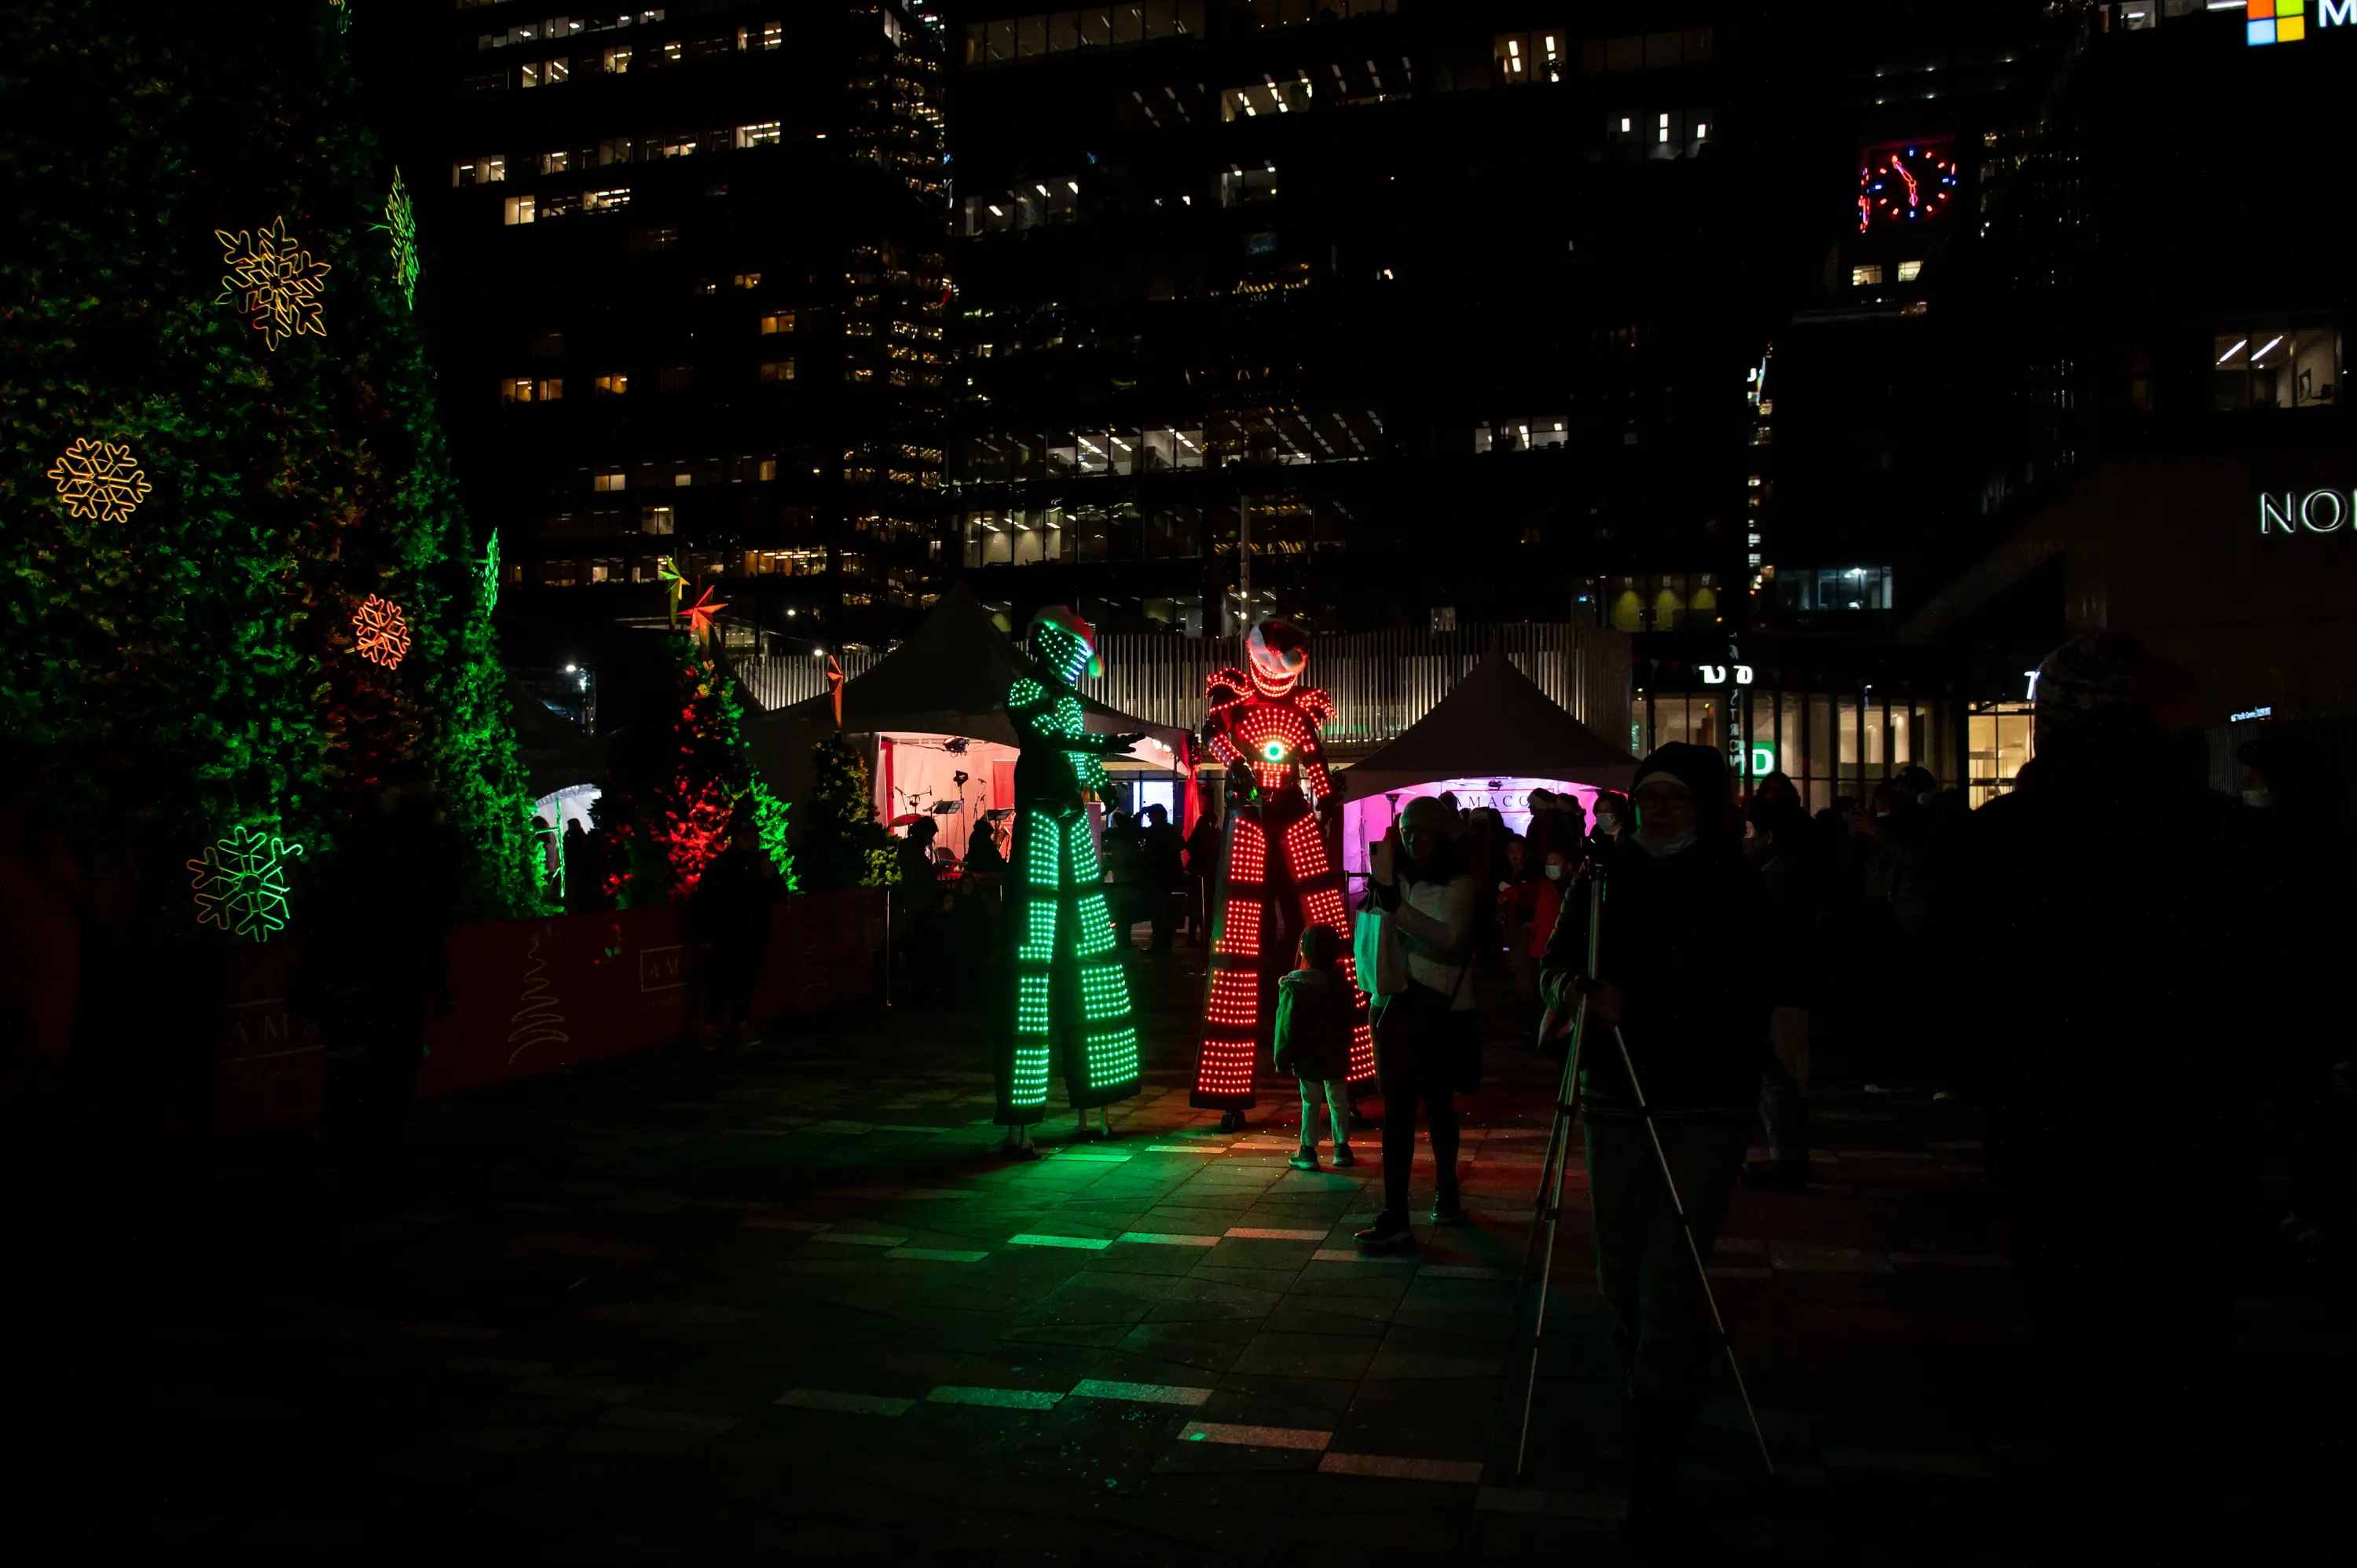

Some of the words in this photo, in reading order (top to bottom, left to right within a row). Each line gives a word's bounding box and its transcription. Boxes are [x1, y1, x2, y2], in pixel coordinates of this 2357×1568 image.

[2319, 0, 2357, 27] M
[2260, 489, 2357, 533] NO
[1455, 795, 1530, 808] AMACO
